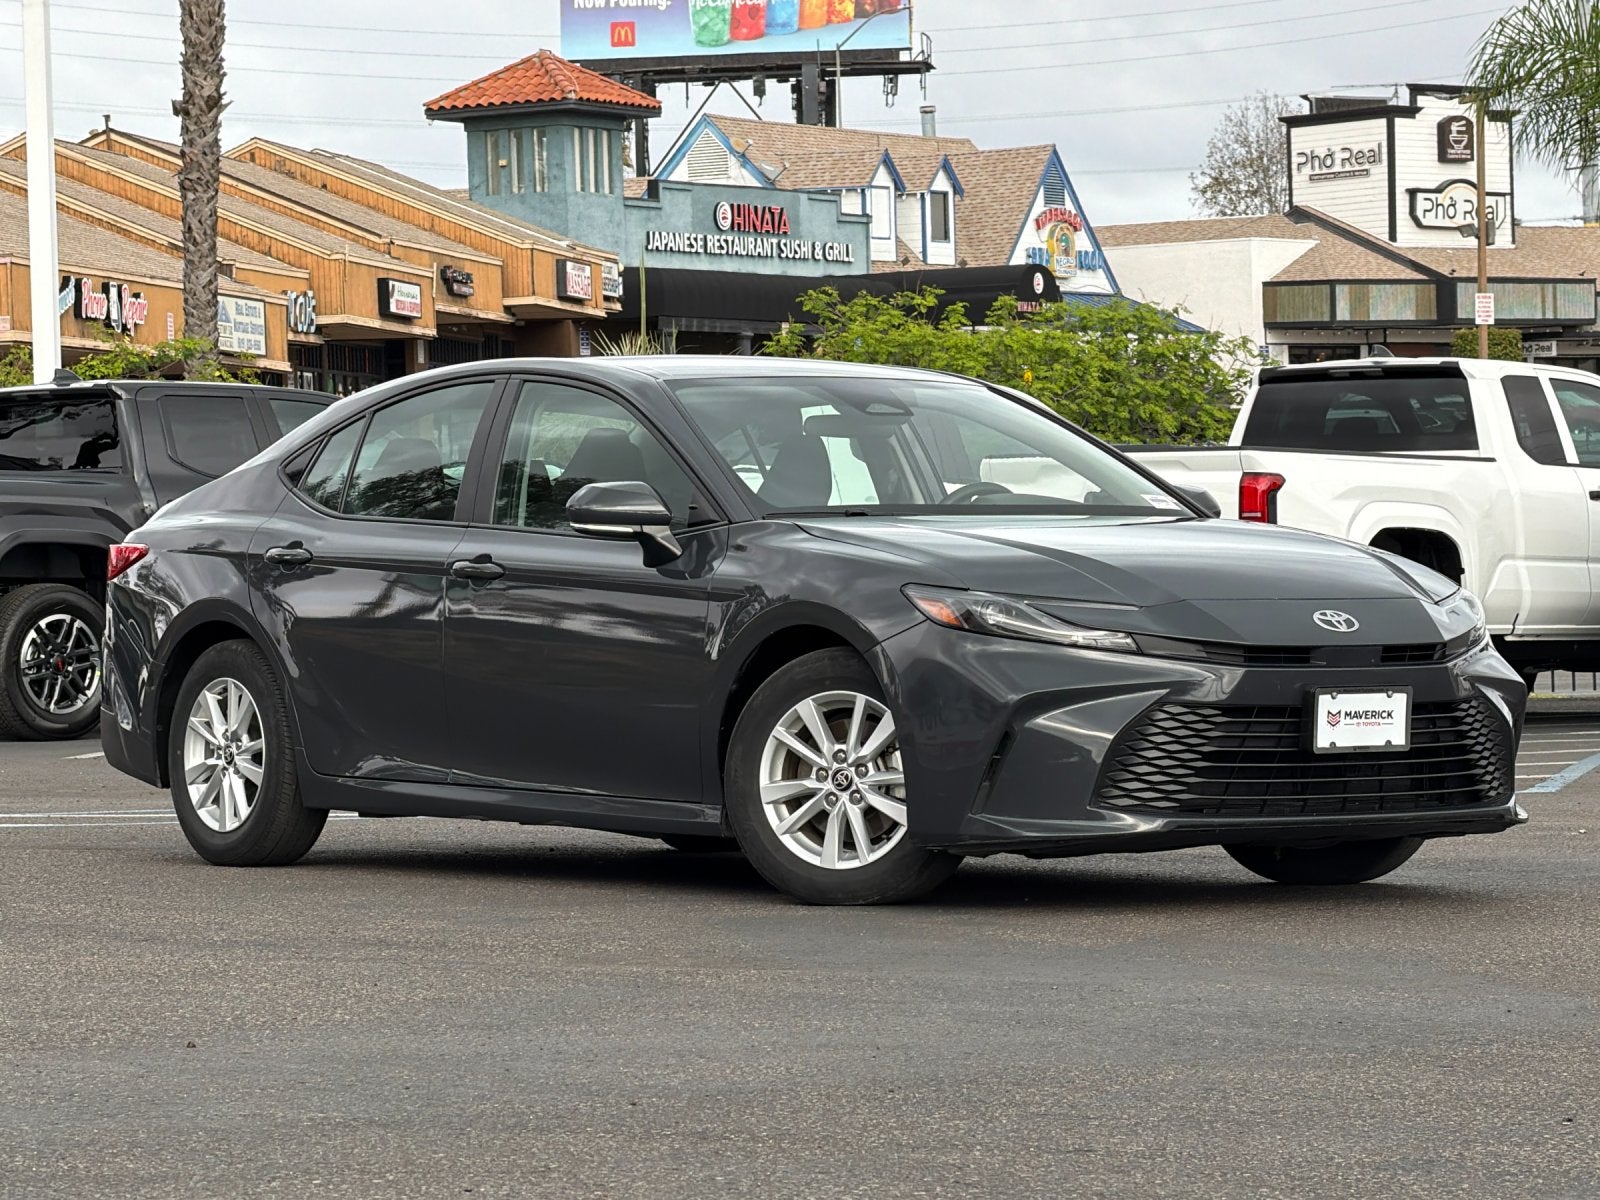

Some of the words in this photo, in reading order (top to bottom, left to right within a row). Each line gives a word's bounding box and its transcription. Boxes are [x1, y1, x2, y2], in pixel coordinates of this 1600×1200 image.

[1341, 142, 1383, 167] Real
[733, 202, 791, 235] HINATA
[648, 230, 703, 253] JAPANESE
[707, 234, 779, 257] RESTAURANT
[781, 239, 812, 259] SUSHI
[814, 242, 823, 260] &
[826, 242, 854, 262] GRILL
[1056, 257, 1074, 267] NEGRO
[82, 277, 107, 320] Phone
[121, 283, 148, 337] Repair
[1535, 342, 1552, 353] Real
[1344, 709, 1394, 720] MAVERICK
